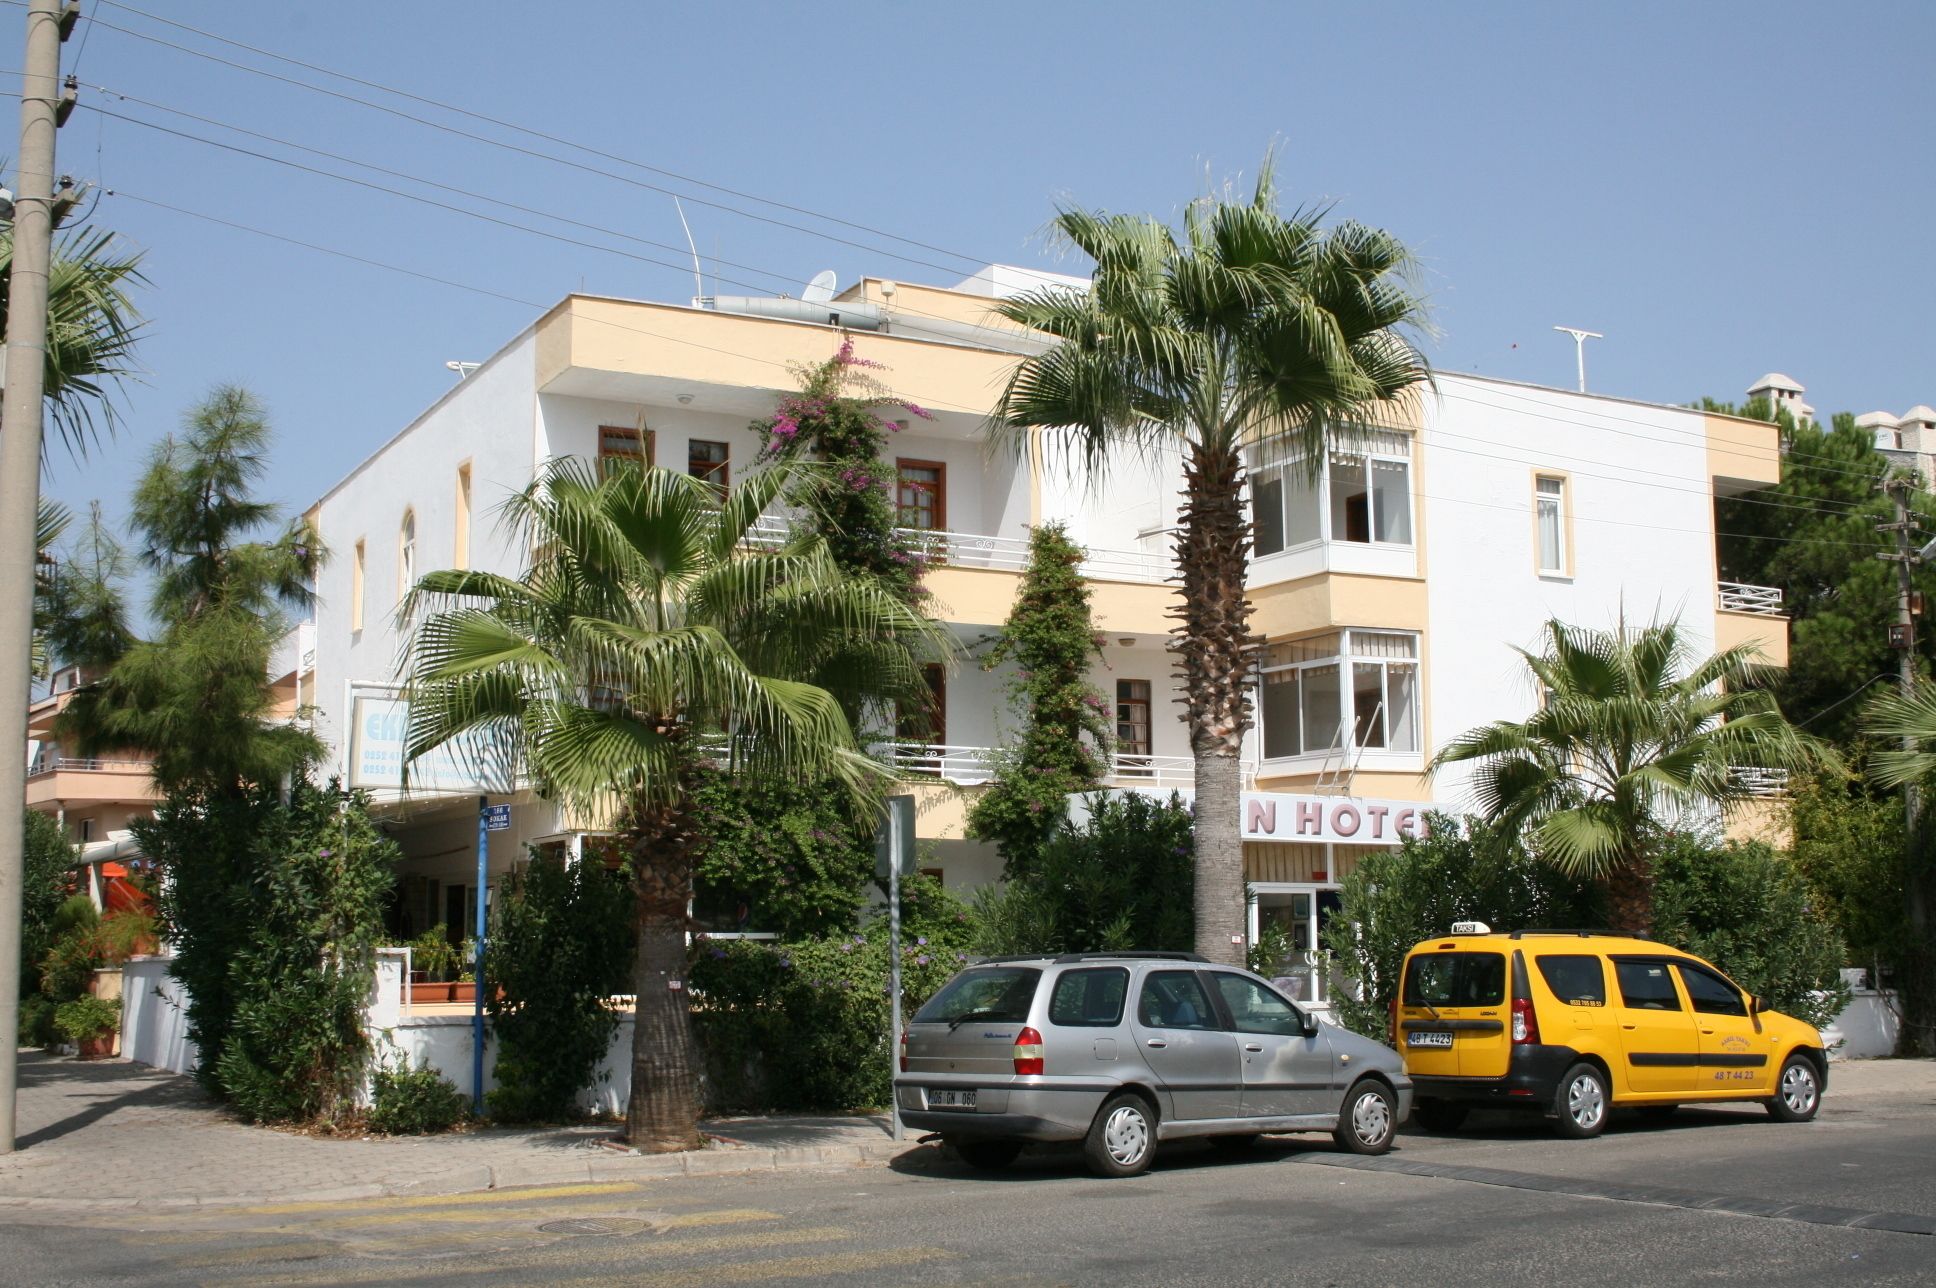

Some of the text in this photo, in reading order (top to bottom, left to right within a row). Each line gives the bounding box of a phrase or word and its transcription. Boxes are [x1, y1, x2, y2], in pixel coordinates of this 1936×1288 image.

[1411, 1033, 1452, 1044] 48 T 4423
[1715, 1070, 1754, 1080] 48 T 44 23
